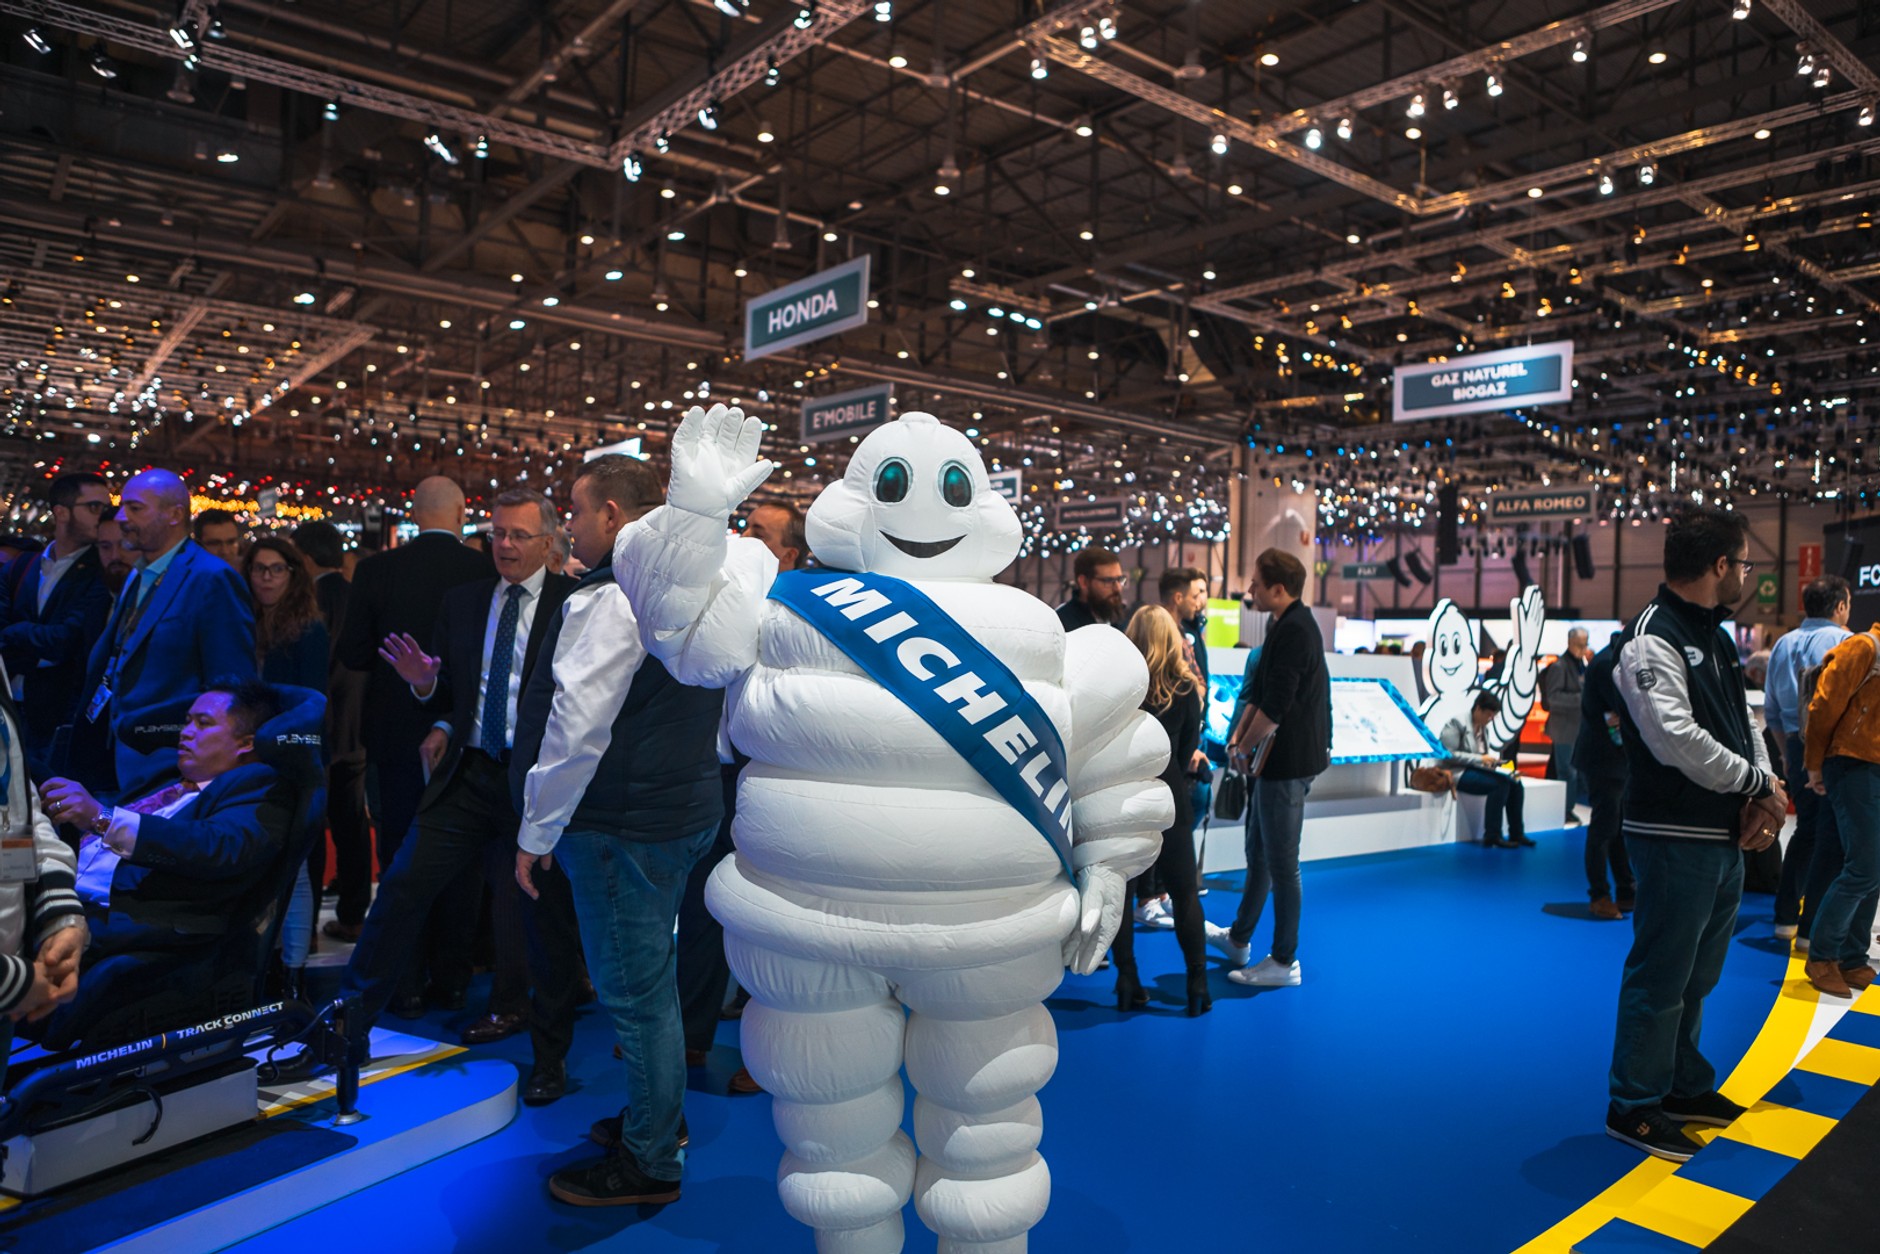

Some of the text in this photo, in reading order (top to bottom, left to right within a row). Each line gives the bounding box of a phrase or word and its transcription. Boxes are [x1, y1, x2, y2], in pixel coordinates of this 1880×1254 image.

[768, 289, 838, 334] HONDA
[1431, 362, 1528, 388] GAZ NATUREL
[1452, 381, 1507, 401] BIOGAZ
[1496, 495, 1586, 513] ALFA ROMEO
[75, 1001, 284, 1070] MICHELIN TRACK CONNECT
